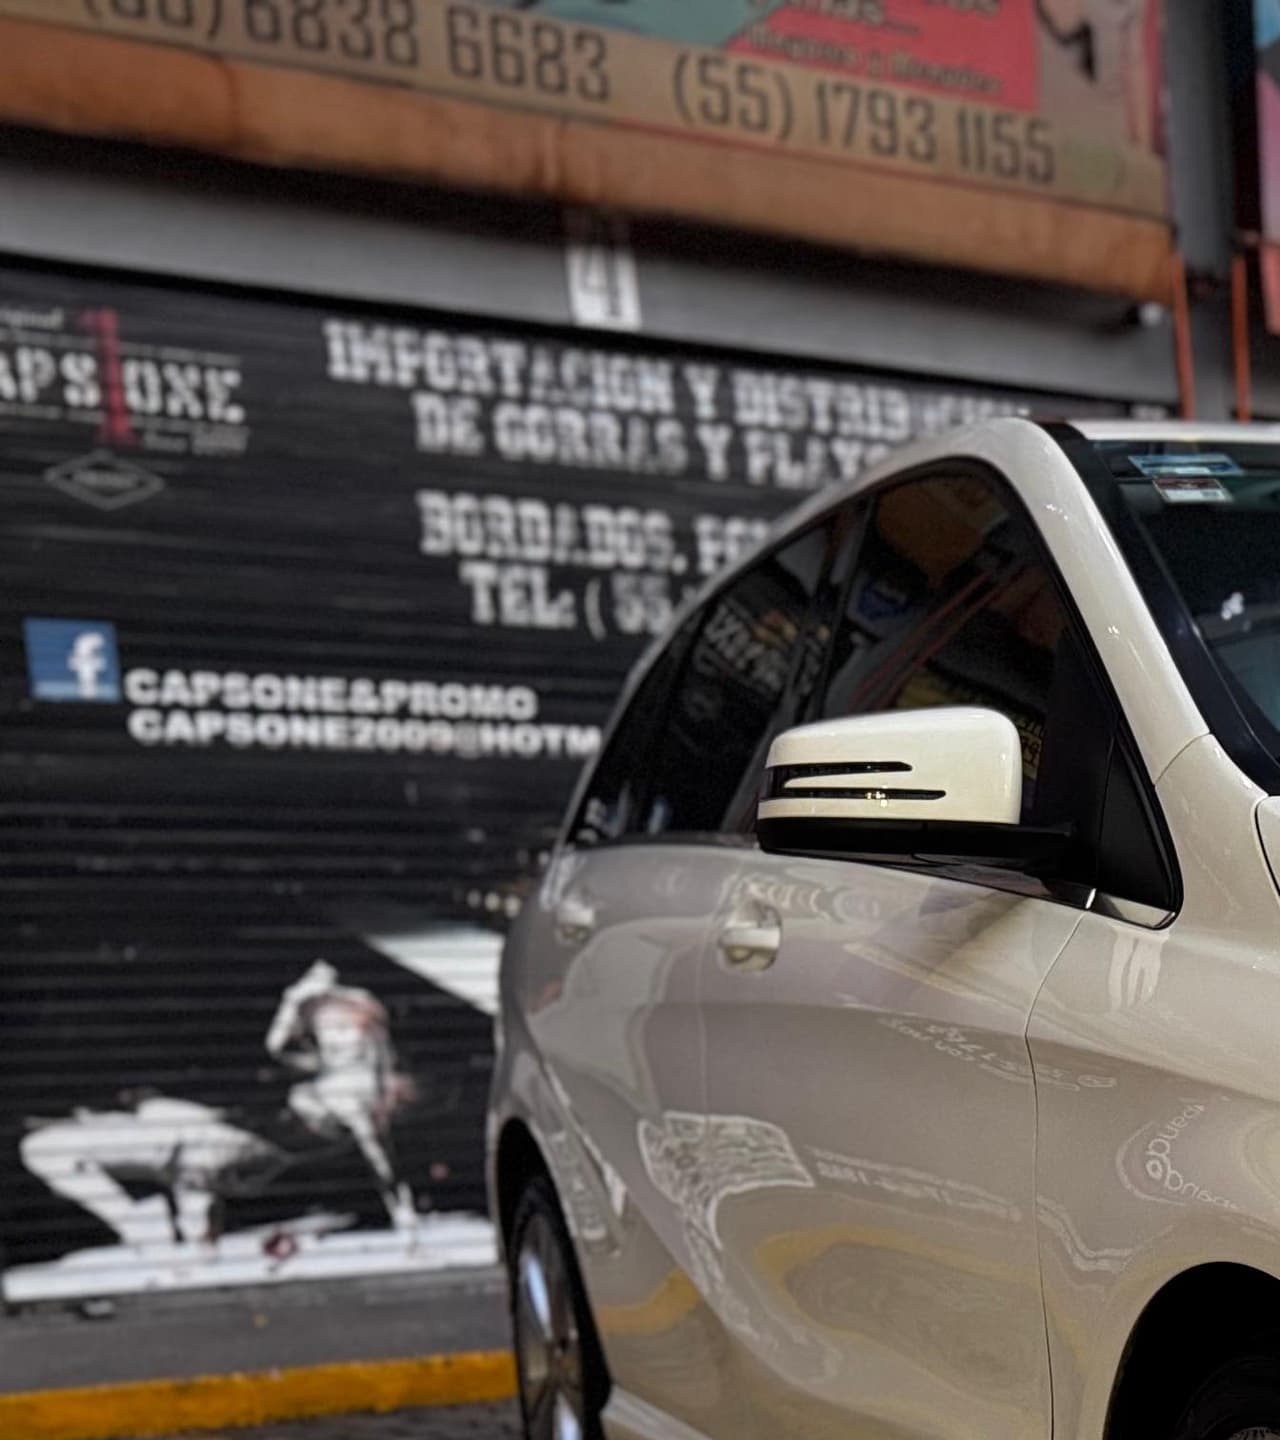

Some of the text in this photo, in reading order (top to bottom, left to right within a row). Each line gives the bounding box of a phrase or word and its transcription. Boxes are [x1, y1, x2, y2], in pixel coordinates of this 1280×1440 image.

[446, 3, 610, 102] 6683
[672, 47, 794, 144] (55)
[814, 77, 938, 164] 1793
[955, 105, 1057, 184] 1155
[410, 391, 486, 456] DE
